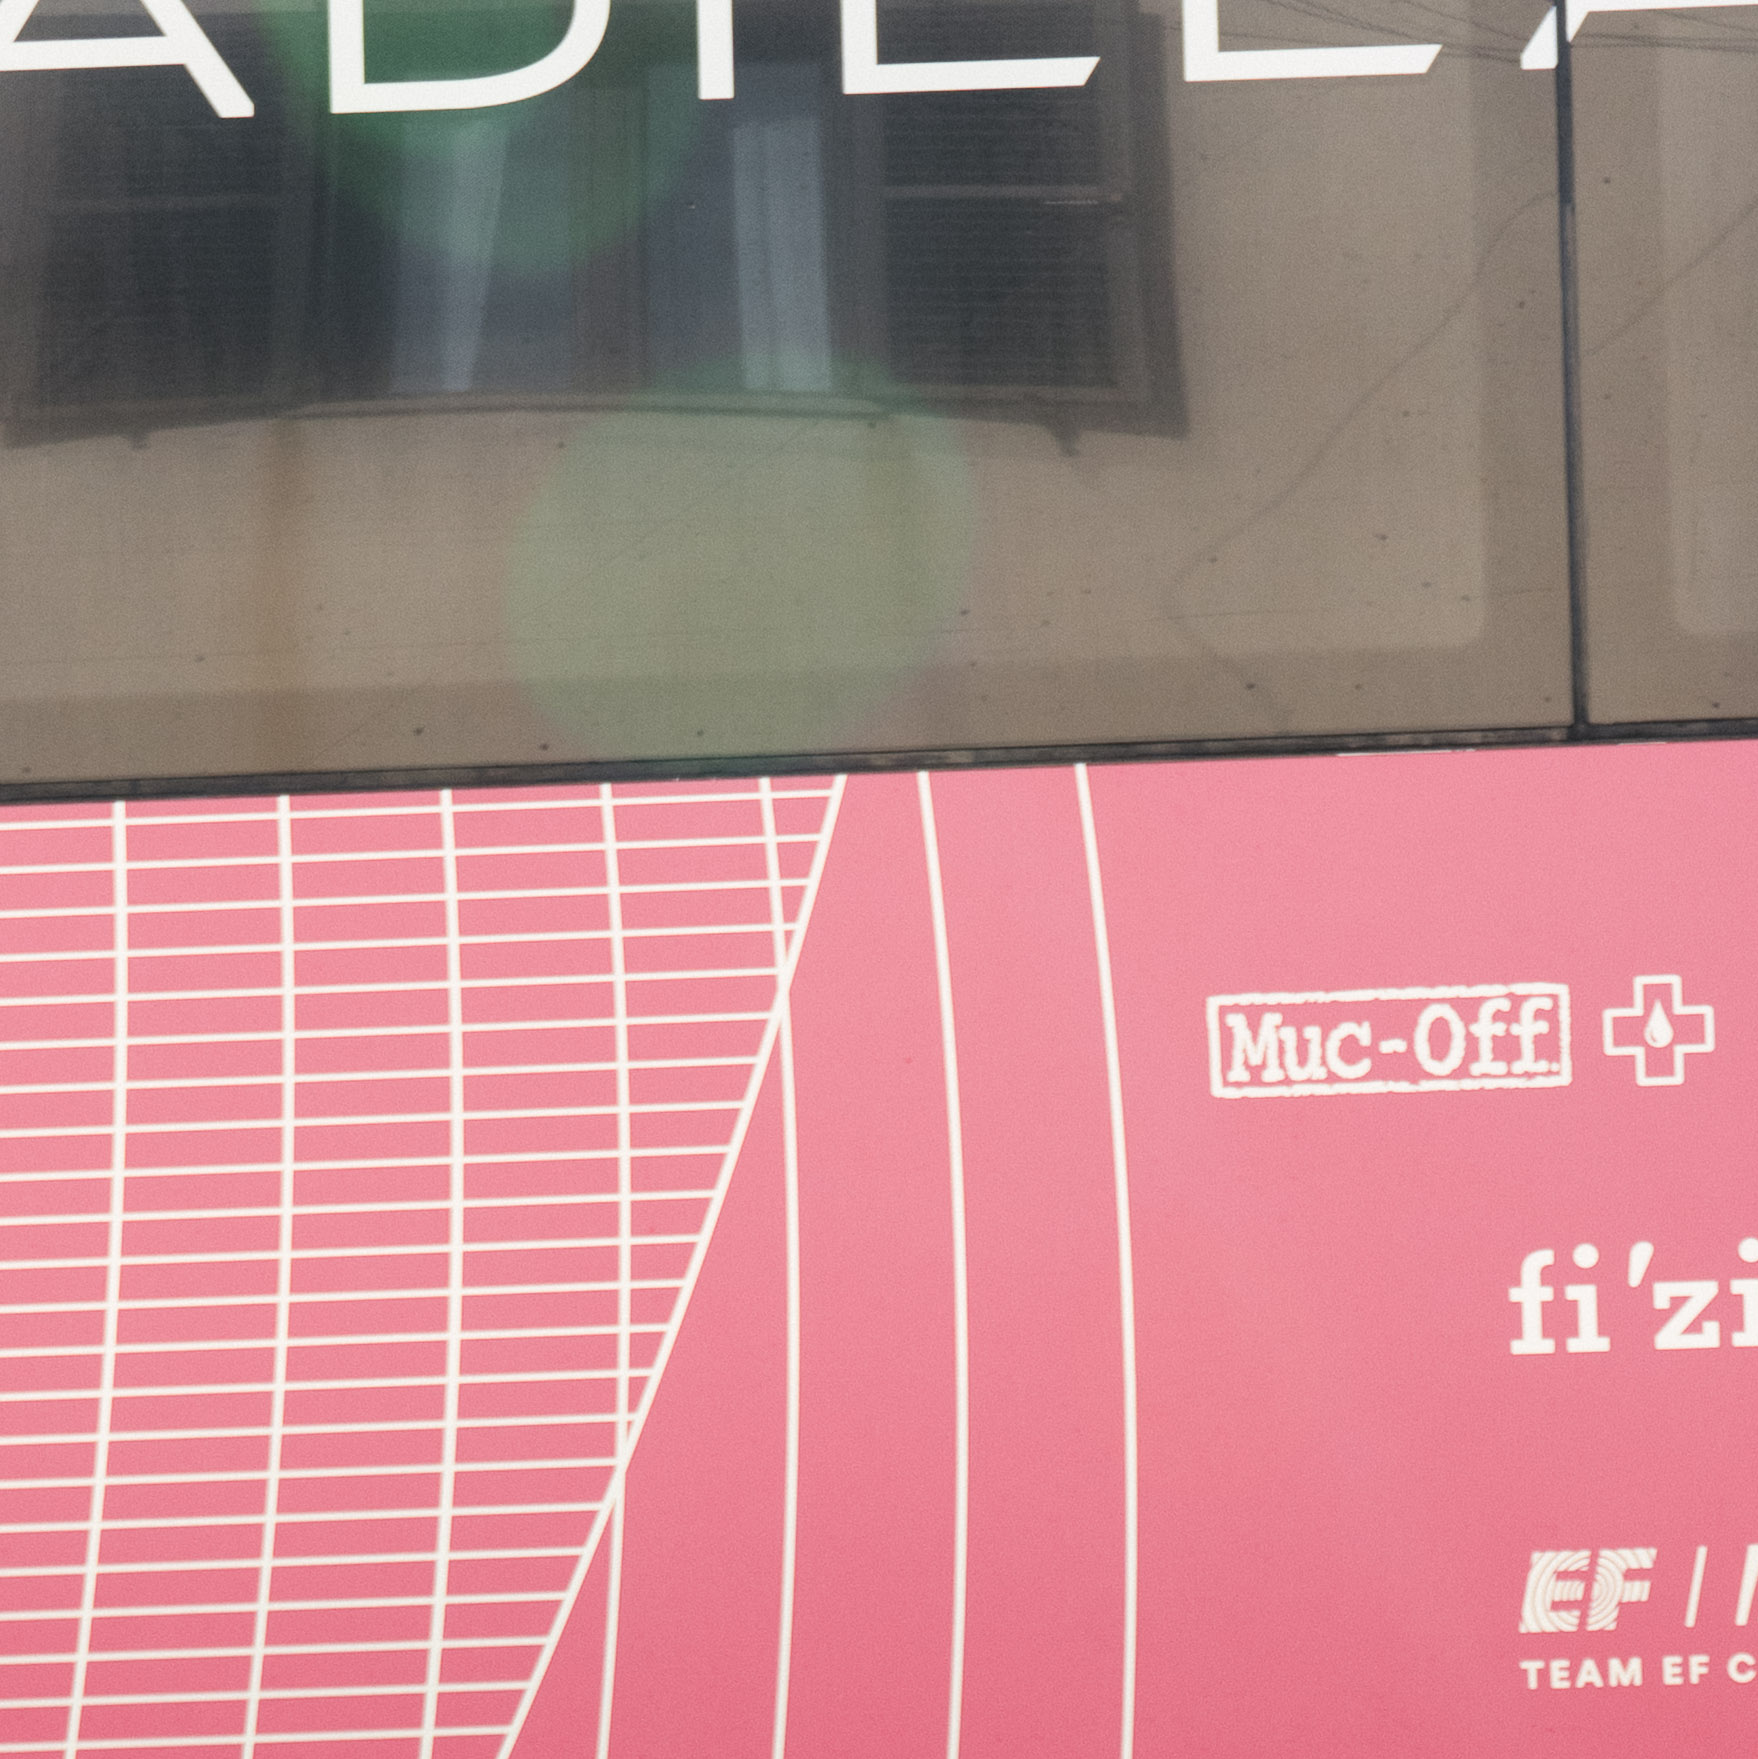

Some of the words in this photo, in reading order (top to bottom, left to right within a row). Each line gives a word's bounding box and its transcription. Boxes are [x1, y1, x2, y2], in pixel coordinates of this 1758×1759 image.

[1224, 996, 1560, 1083] Muc-Off
[1519, 1547, 1659, 1634] EF
[1519, 1657, 1643, 1690] TEAM
[1661, 1654, 1711, 1686] EF
